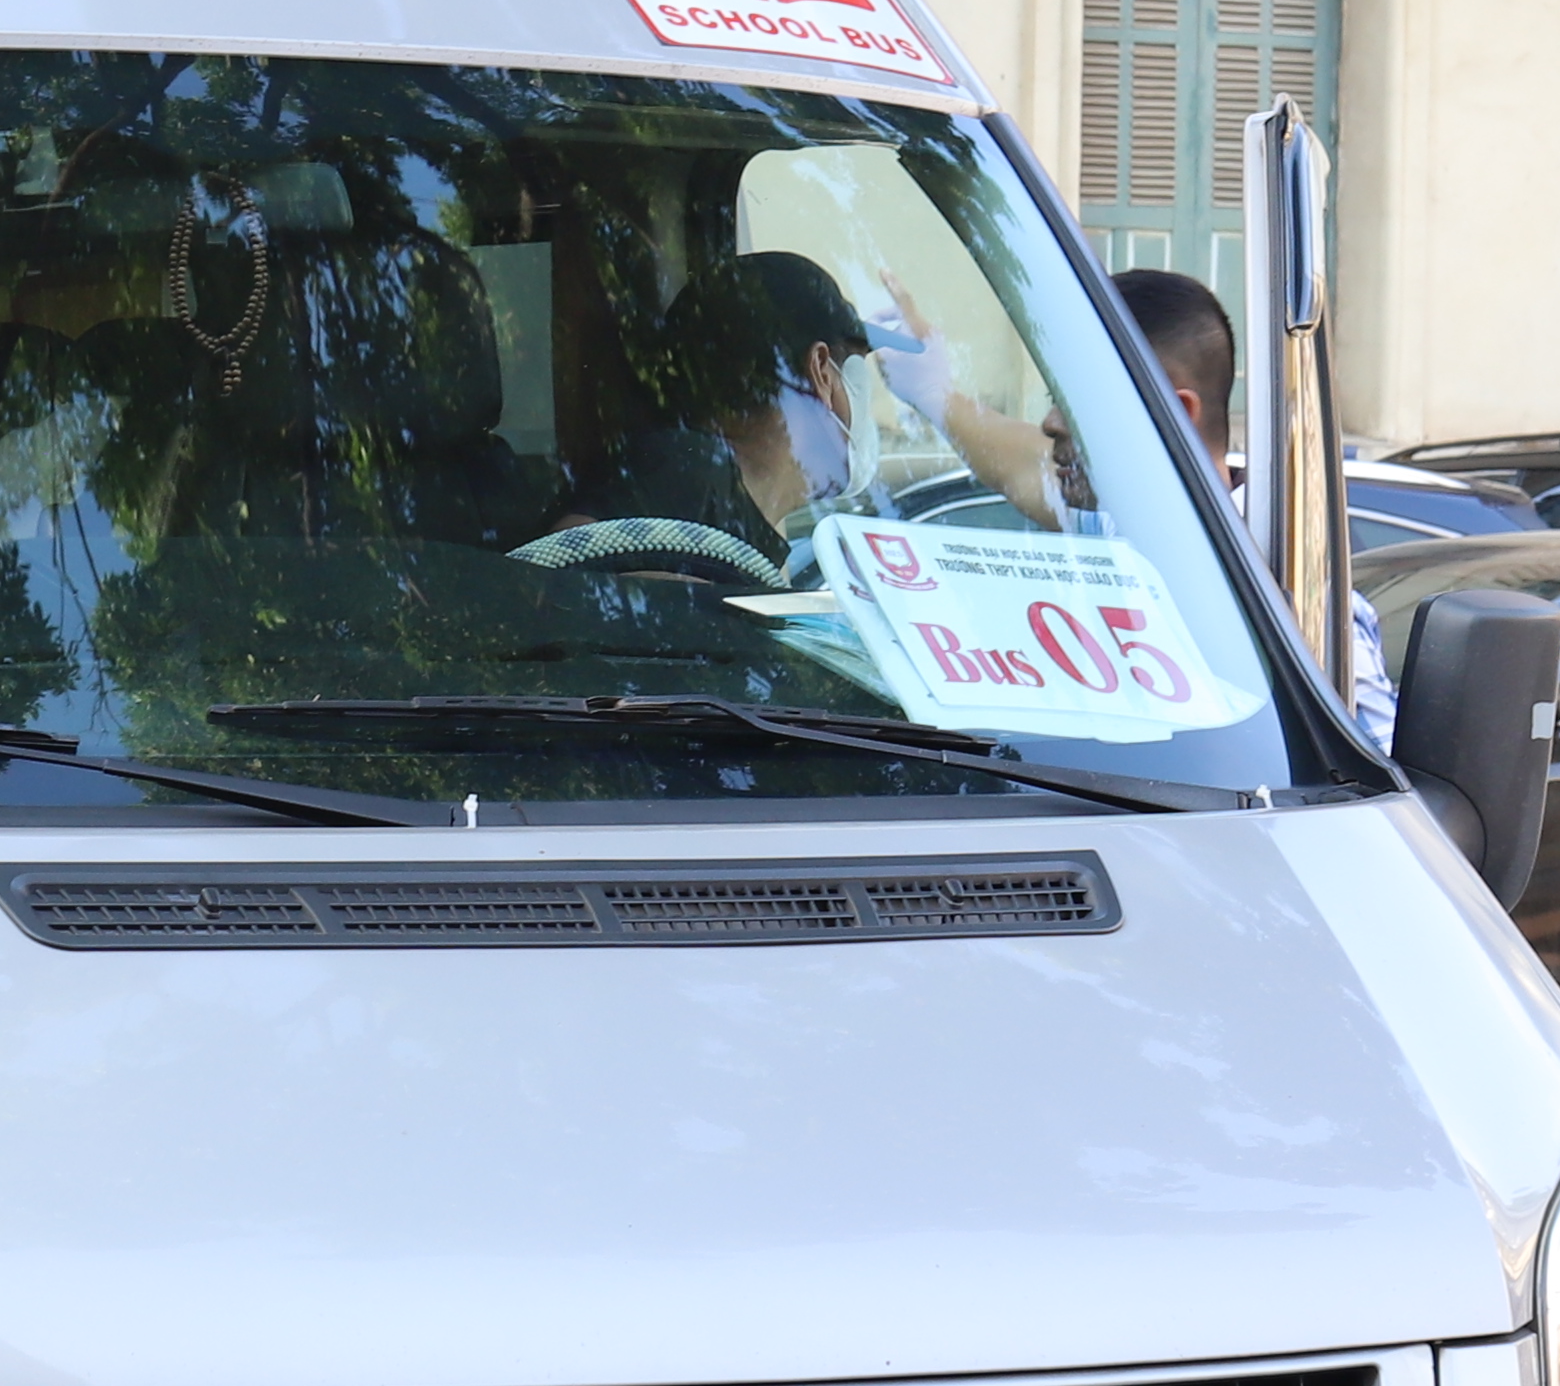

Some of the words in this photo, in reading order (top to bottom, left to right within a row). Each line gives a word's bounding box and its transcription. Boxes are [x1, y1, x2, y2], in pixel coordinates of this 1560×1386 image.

[657, 3, 838, 44] SCHOOL
[839, 25, 924, 62] BUS
[934, 557, 986, 575] TRƯỜNG
[985, 562, 1018, 578] THPT
[1017, 566, 1054, 581] KHOA
[1053, 568, 1081, 585] HỌC
[1081, 569, 1113, 586] GIÁO
[1112, 573, 1140, 591] DỤC
[910, 622, 1045, 688] Bus
[1027, 600, 1193, 704] 05
